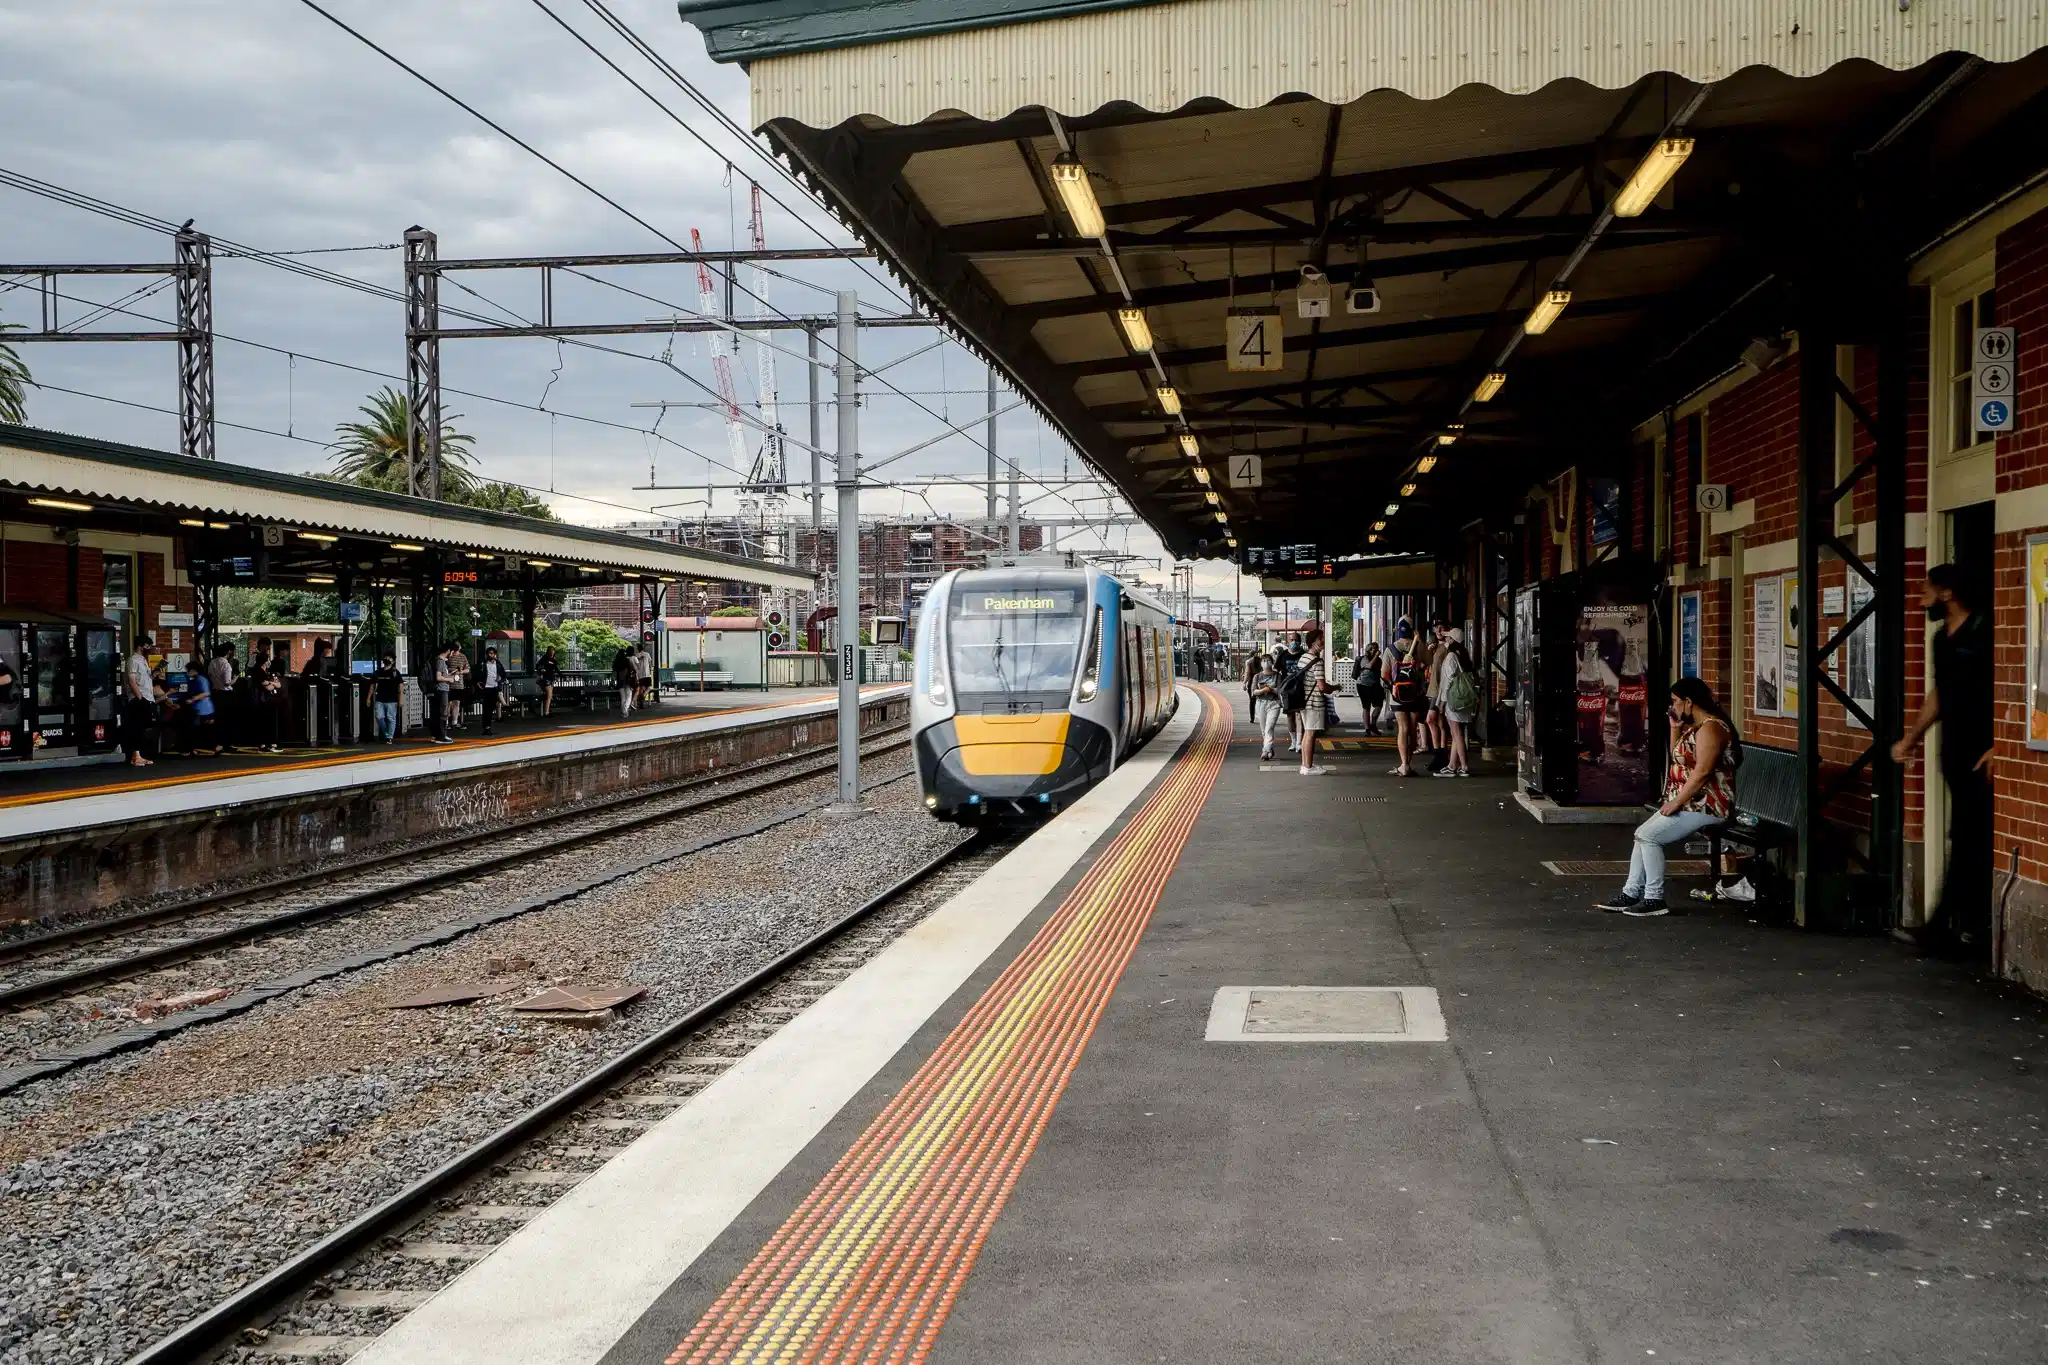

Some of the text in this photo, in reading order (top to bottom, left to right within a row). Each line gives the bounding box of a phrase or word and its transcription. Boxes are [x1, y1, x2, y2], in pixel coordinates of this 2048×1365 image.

[1239, 320, 1271, 366] 4
[1237, 457, 1255, 484] 4
[268, 527, 279, 544] 3
[508, 556, 516, 569] 3
[984, 597, 1055, 610] Pakenham
[42, 728, 62, 737] SNACKS
